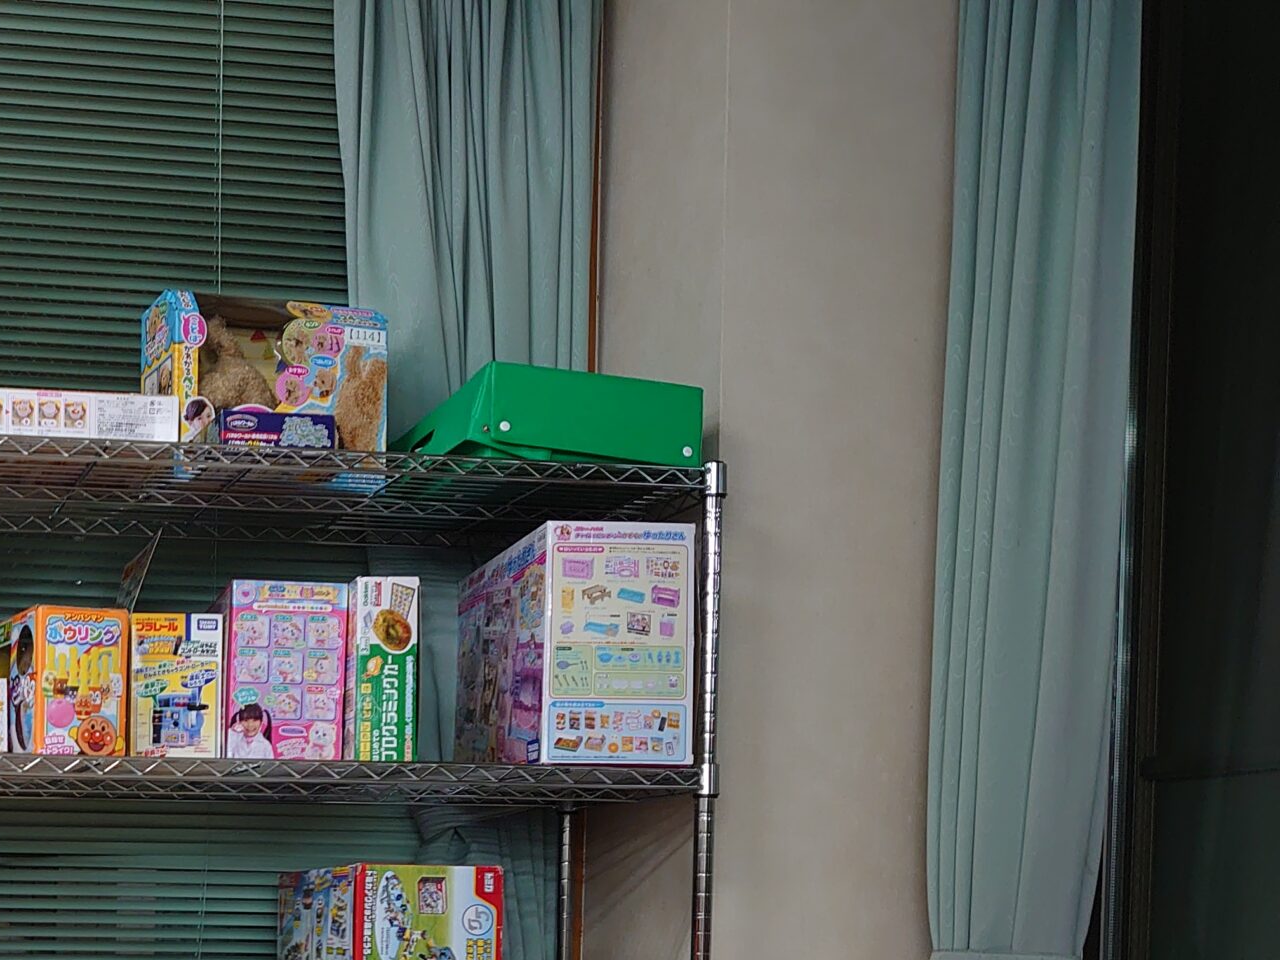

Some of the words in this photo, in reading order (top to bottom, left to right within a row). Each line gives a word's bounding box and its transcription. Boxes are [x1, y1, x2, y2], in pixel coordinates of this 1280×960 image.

[64, 613, 105, 622] アンパンマン
[46, 622, 121, 644] ボウリング
[135, 622, 178, 632] プラレール
[380, 654, 399, 762] プログラミングカー
